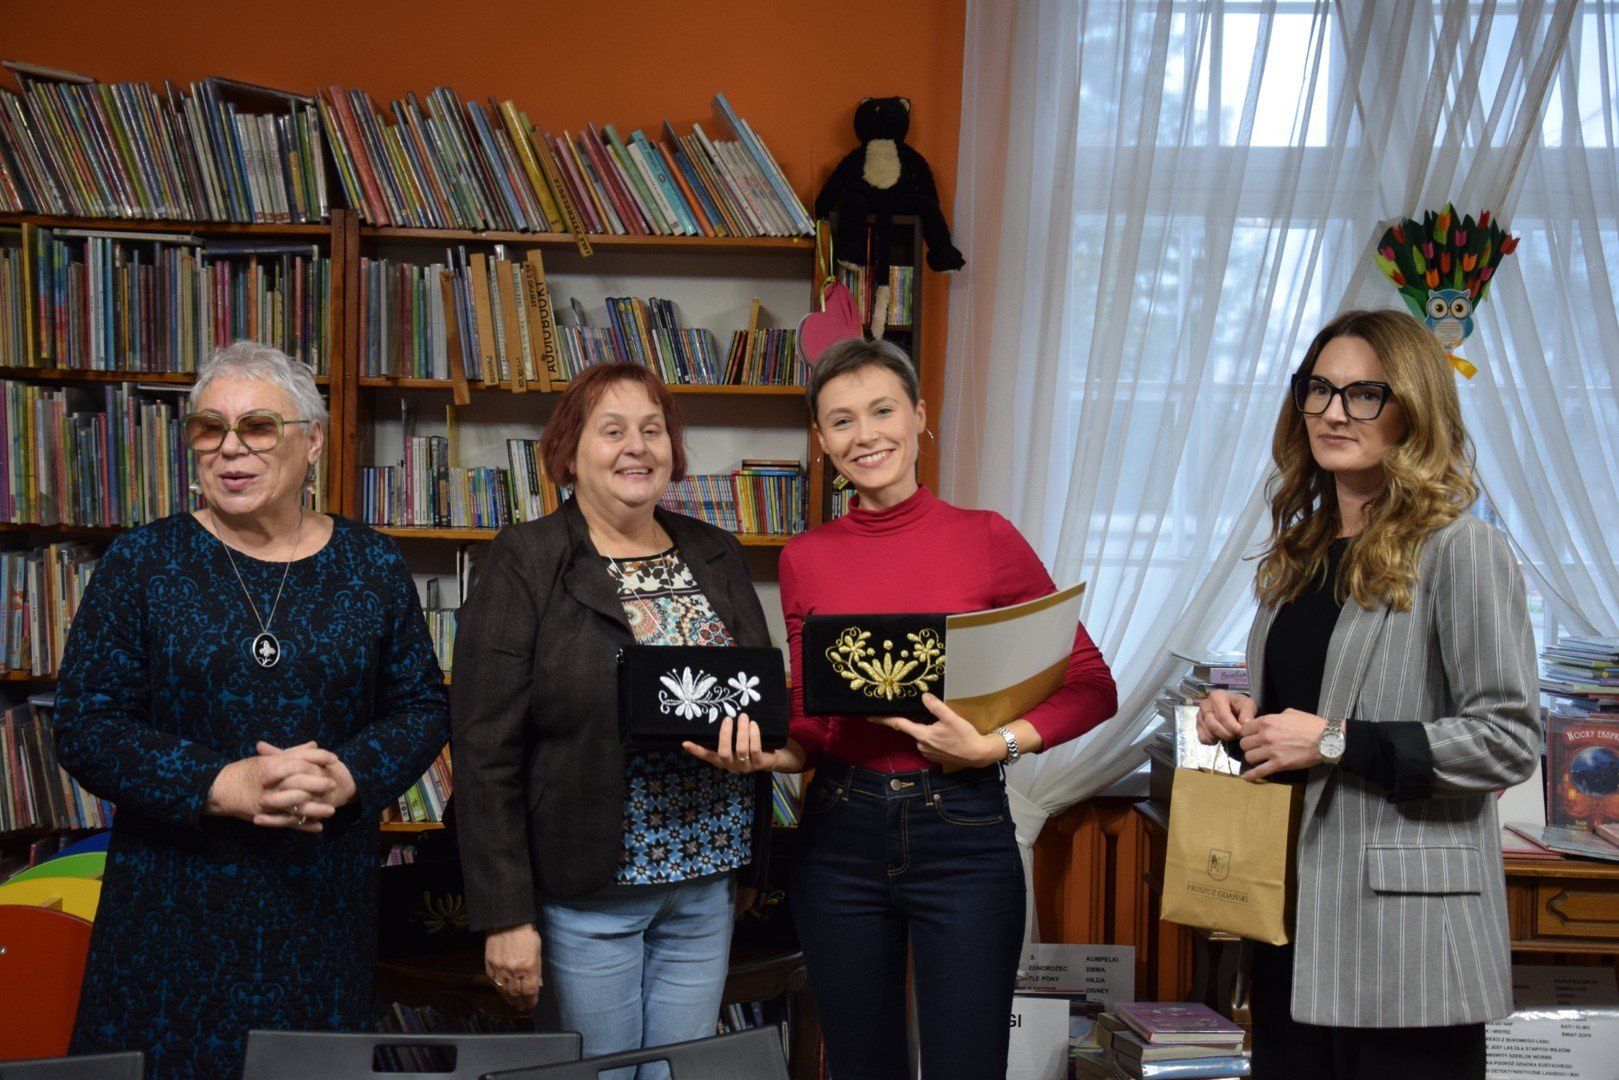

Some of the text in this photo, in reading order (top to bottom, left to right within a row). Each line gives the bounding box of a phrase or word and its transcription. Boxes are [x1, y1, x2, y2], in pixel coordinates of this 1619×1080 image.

[527, 281, 537, 307] DRAMAT
[1567, 730, 1595, 742] NOCNY
[1010, 1013, 1022, 1028] GI
